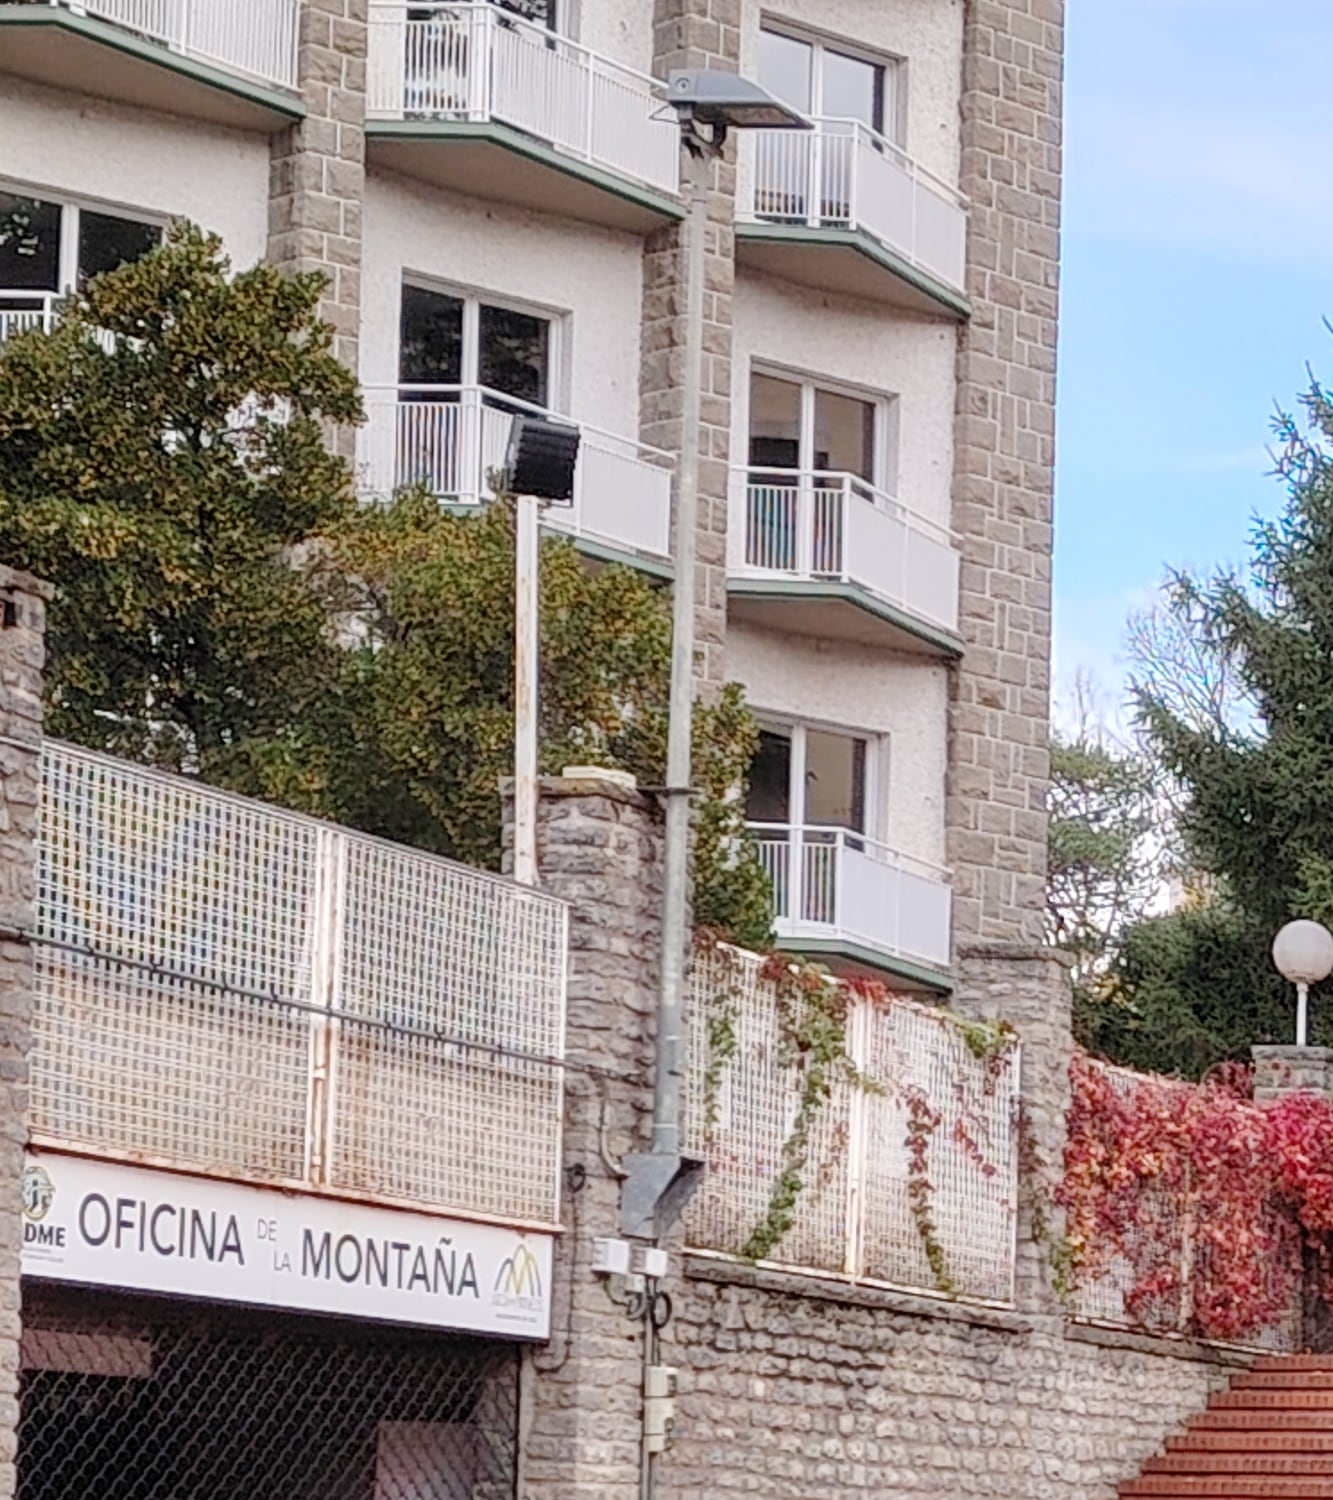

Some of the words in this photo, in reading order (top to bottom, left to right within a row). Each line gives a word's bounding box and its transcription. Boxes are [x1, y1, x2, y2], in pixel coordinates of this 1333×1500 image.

[79, 1192, 245, 1266] OFICINA
[257, 1218, 278, 1242] DE
[273, 1251, 292, 1272] LA
[301, 1227, 481, 1299] MONTAÑA
